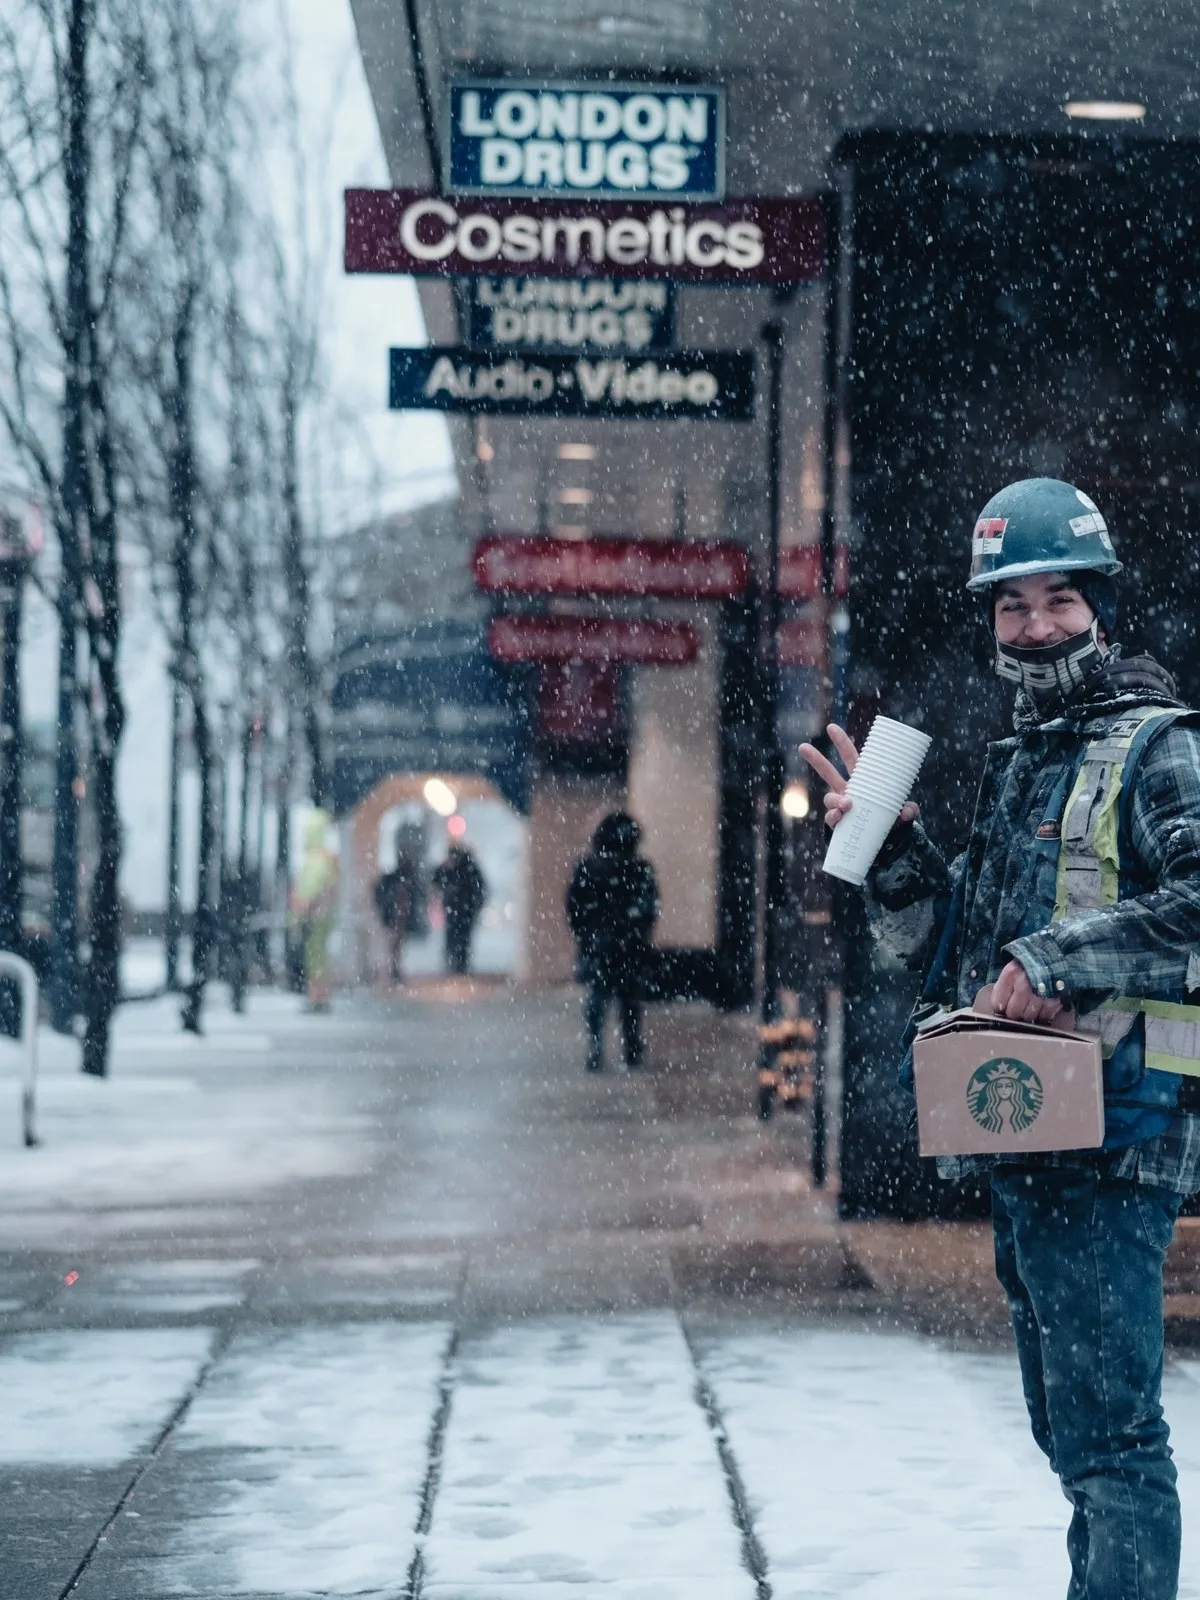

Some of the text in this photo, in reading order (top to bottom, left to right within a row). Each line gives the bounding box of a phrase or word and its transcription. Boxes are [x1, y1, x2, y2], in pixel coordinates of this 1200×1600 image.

[460, 90, 708, 142] LONDON
[479, 140, 691, 188] DRUGS
[400, 200, 766, 269] Cosmetics
[492, 307, 654, 348] DRUGS
